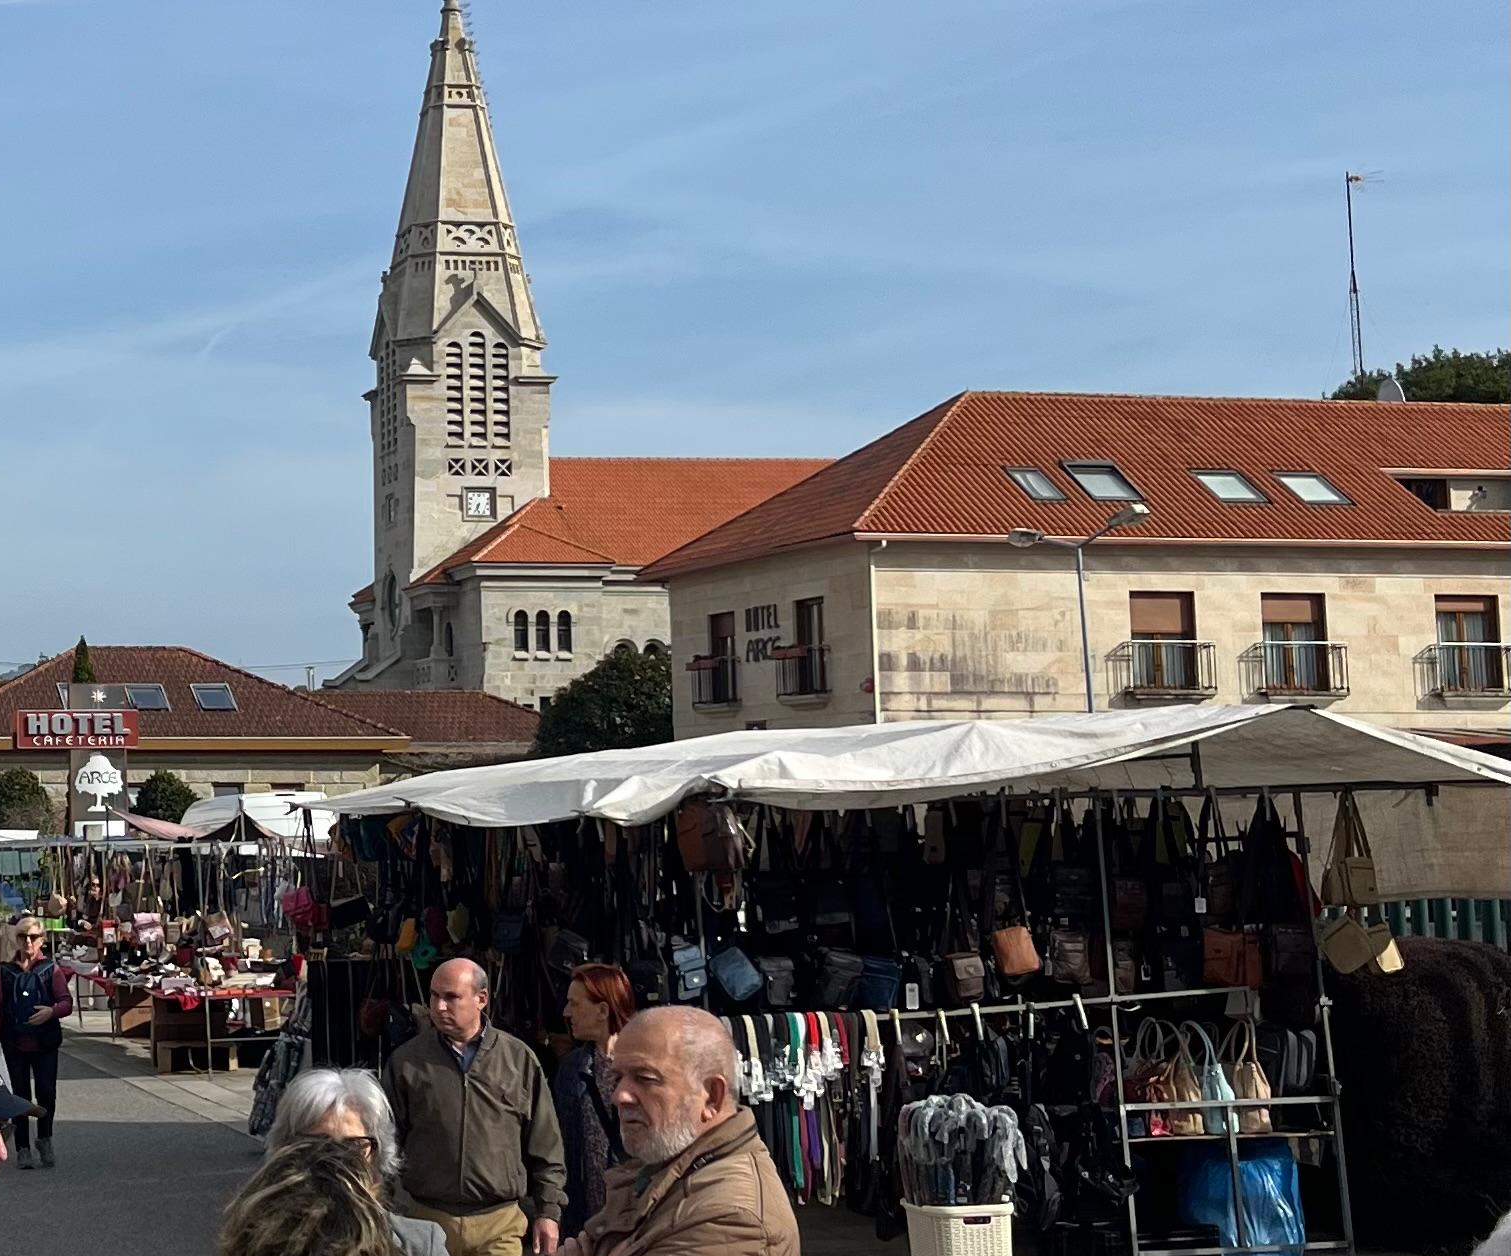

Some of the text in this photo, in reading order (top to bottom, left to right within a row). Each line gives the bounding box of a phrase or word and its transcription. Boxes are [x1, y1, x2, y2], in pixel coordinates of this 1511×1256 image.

[745, 604, 780, 632] HOTEL
[26, 713, 131, 736] HOTEL
[32, 735, 125, 746] CAFETERIA
[78, 771, 119, 784] ARCE
